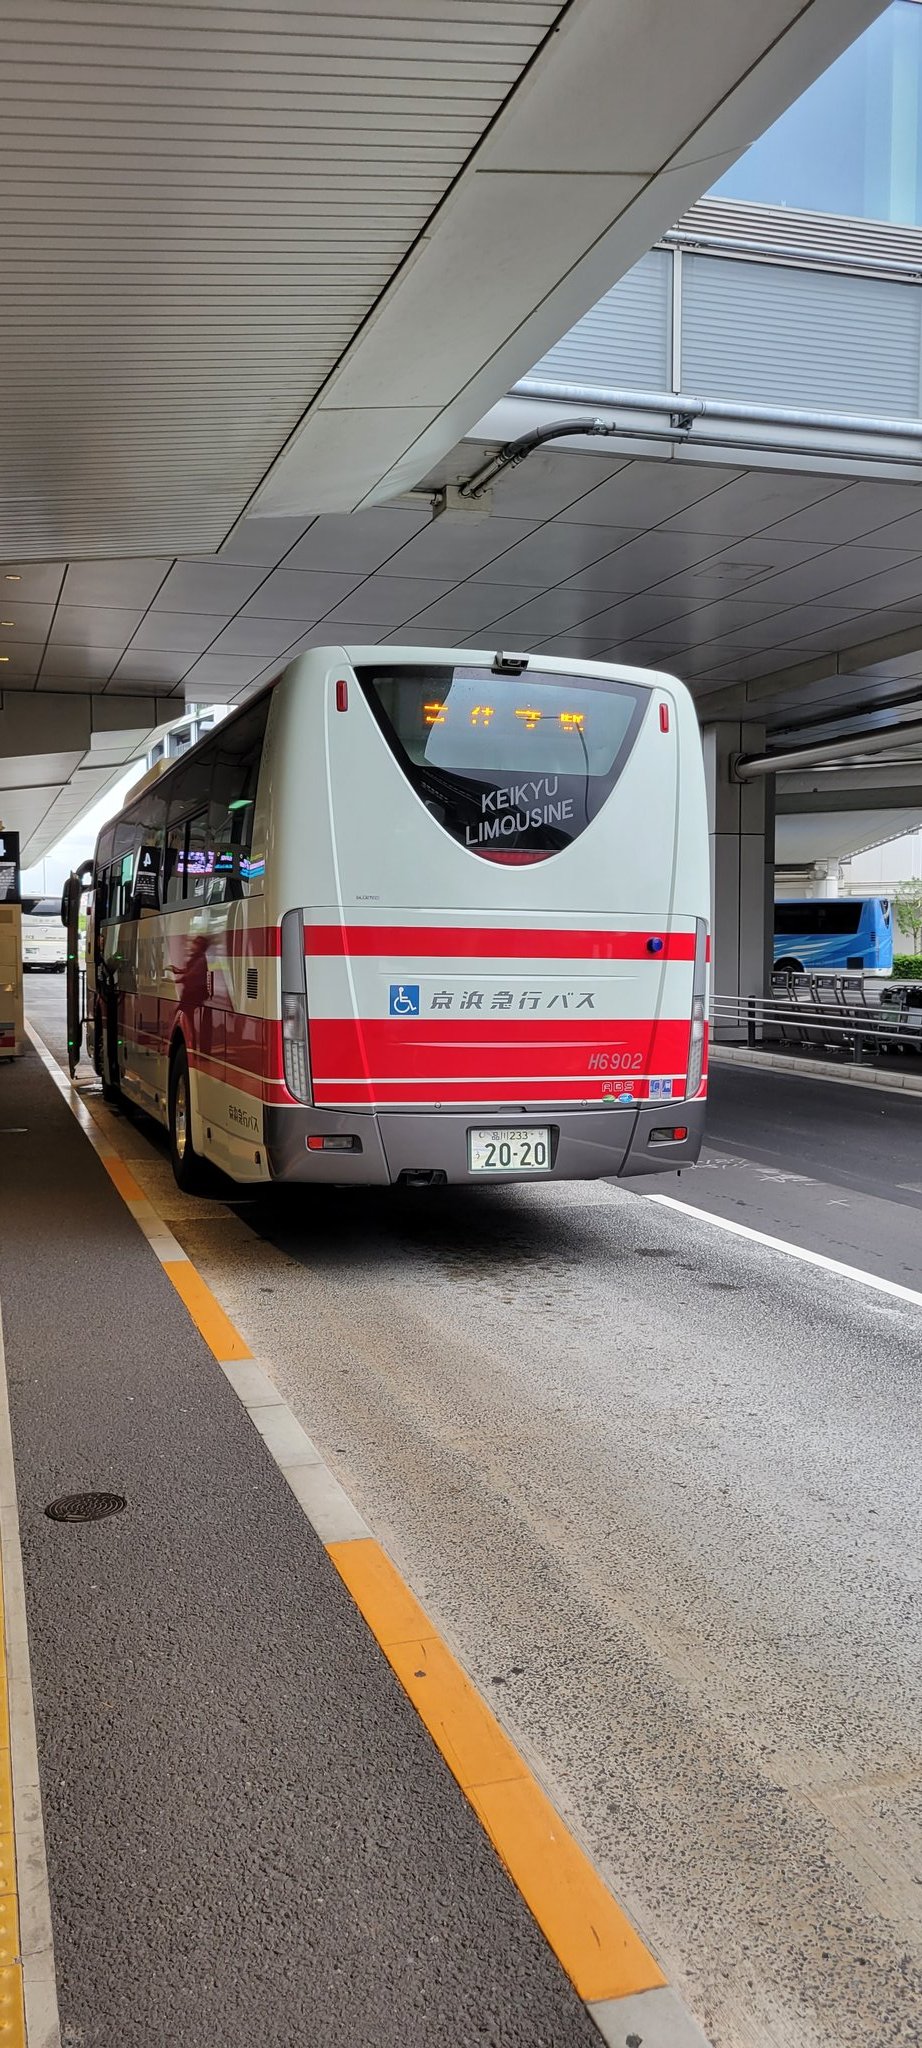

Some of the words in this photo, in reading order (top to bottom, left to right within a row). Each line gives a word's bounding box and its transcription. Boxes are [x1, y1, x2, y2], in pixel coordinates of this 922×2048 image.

[481, 776, 558, 814] KEIKYU
[466, 799, 574, 845] LIMOUSINE
[430, 990, 596, 1010] 京浜急行バス
[588, 1053, 643, 1070] H6902
[602, 1081, 634, 1093] ABS
[484, 1141, 546, 1167] 20-20
